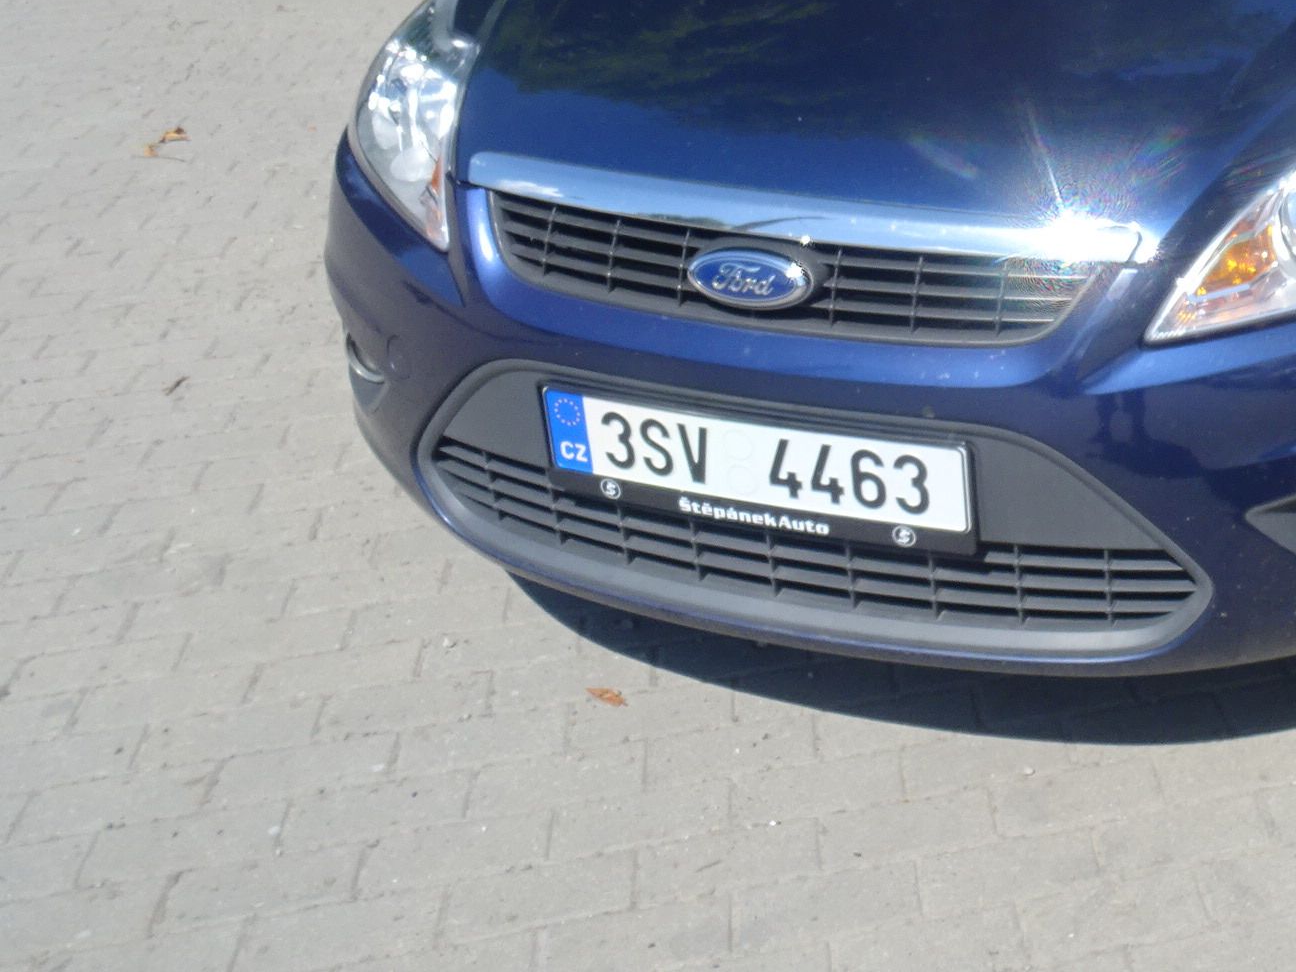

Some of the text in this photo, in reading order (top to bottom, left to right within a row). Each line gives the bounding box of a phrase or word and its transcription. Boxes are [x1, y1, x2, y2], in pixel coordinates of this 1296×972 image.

[711, 262, 776, 296] Ford
[559, 440, 589, 464] CZ
[600, 410, 931, 516] 3SV 4463
